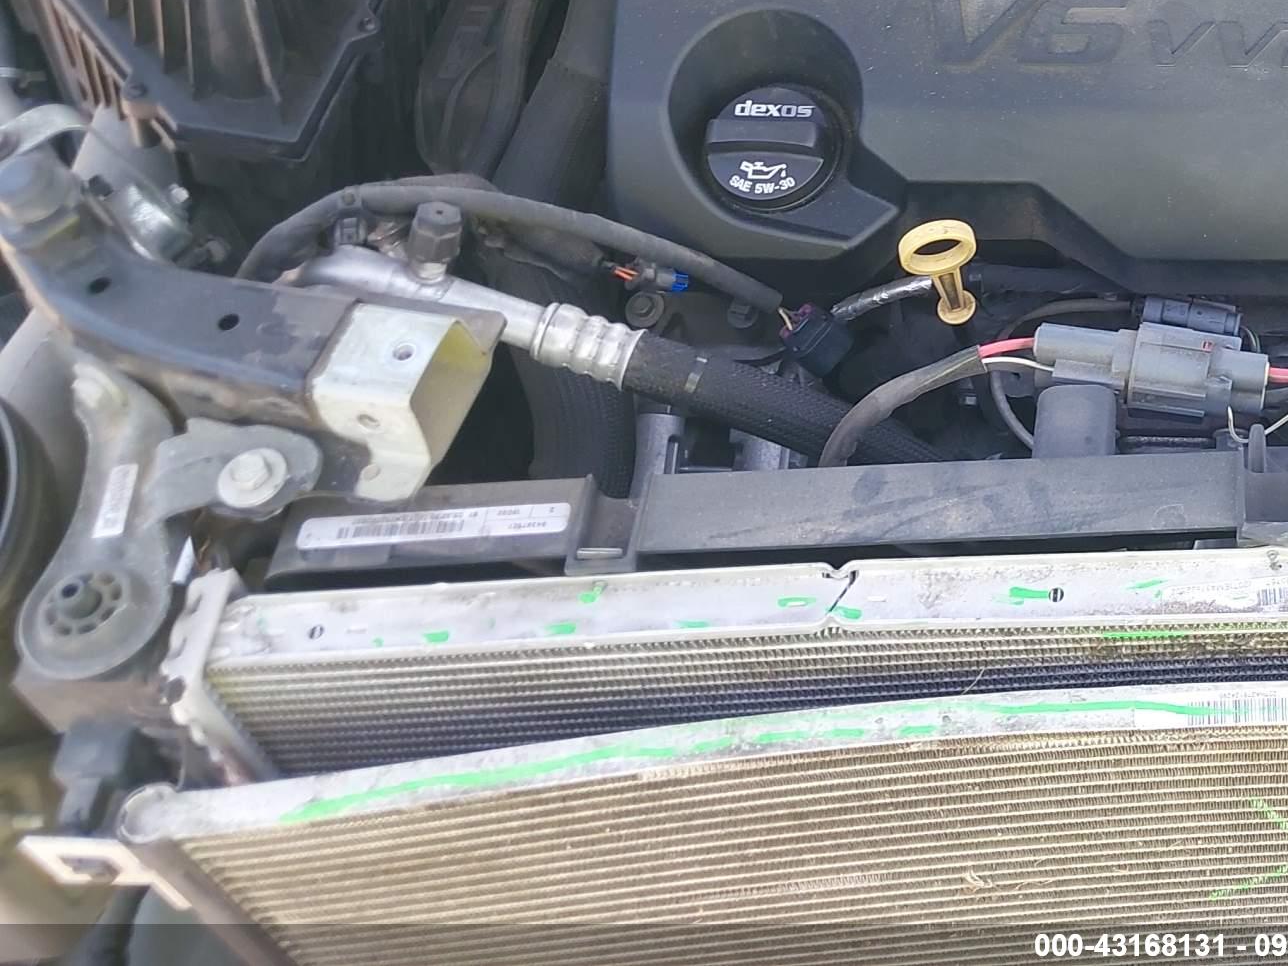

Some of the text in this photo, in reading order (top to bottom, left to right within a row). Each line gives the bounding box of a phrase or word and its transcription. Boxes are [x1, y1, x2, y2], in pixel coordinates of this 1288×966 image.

[734, 99, 816, 118] dexos
[729, 175, 796, 194] SAE 5W-30
